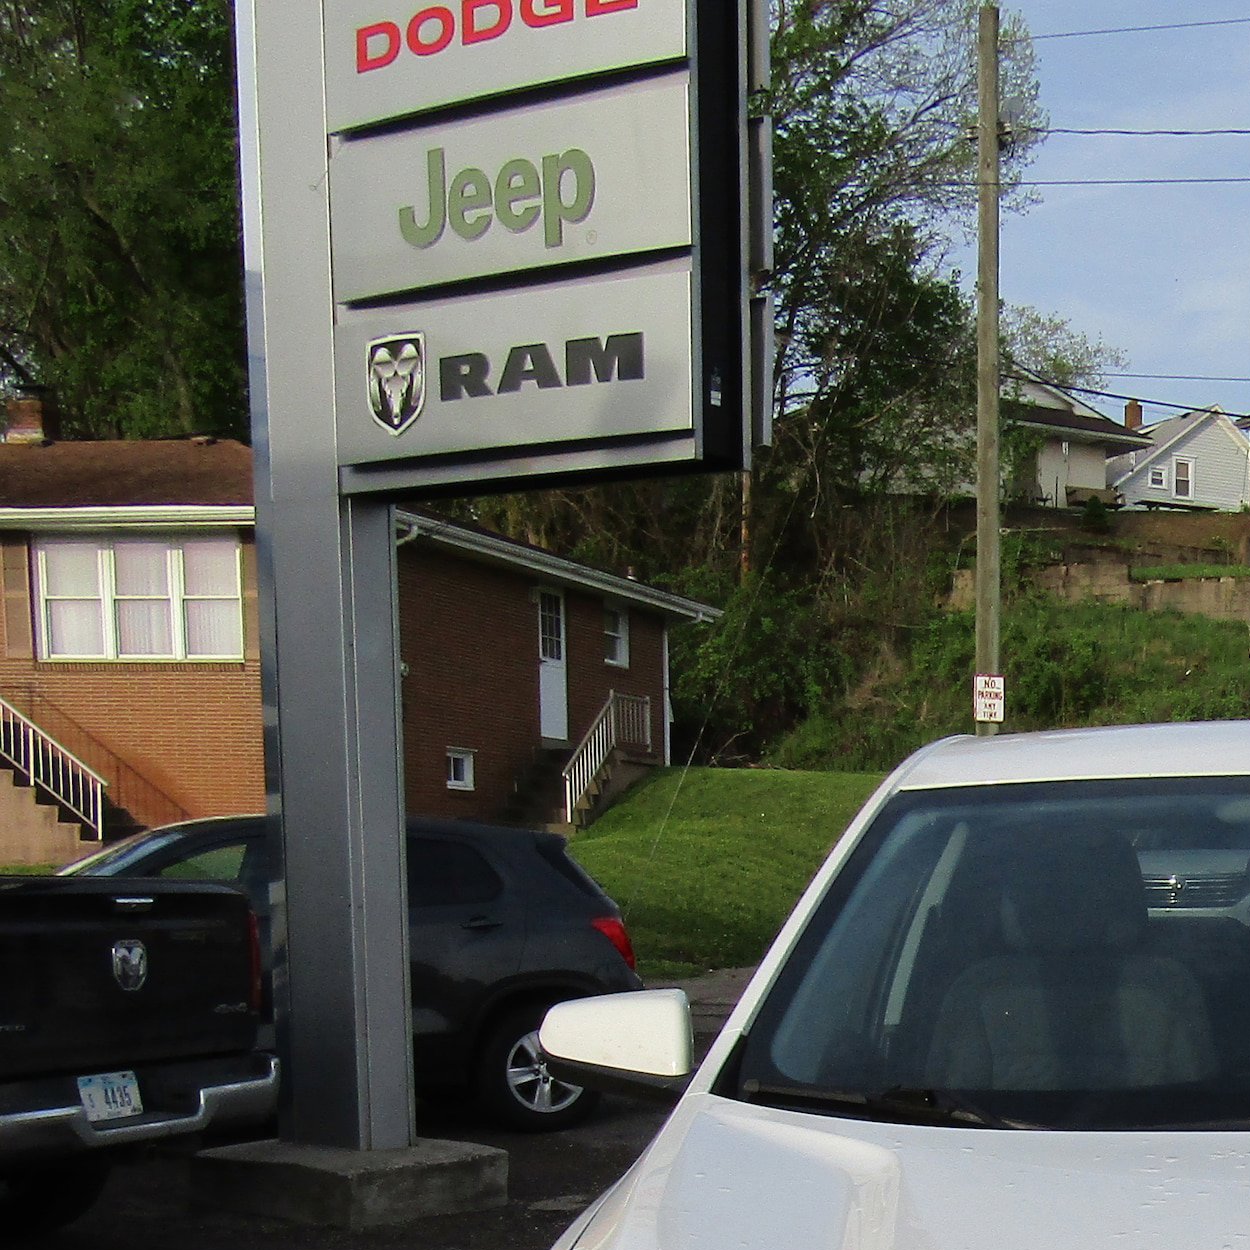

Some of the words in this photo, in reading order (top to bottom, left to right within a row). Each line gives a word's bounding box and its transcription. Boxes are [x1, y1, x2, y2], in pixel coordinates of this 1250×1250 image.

[399, 148, 596, 248] Jeep
[439, 332, 645, 402] RAM
[984, 680, 997, 689] NO
[978, 690, 1003, 700] PARKING
[983, 702, 997, 710] ANY
[982, 711, 998, 719] TIME
